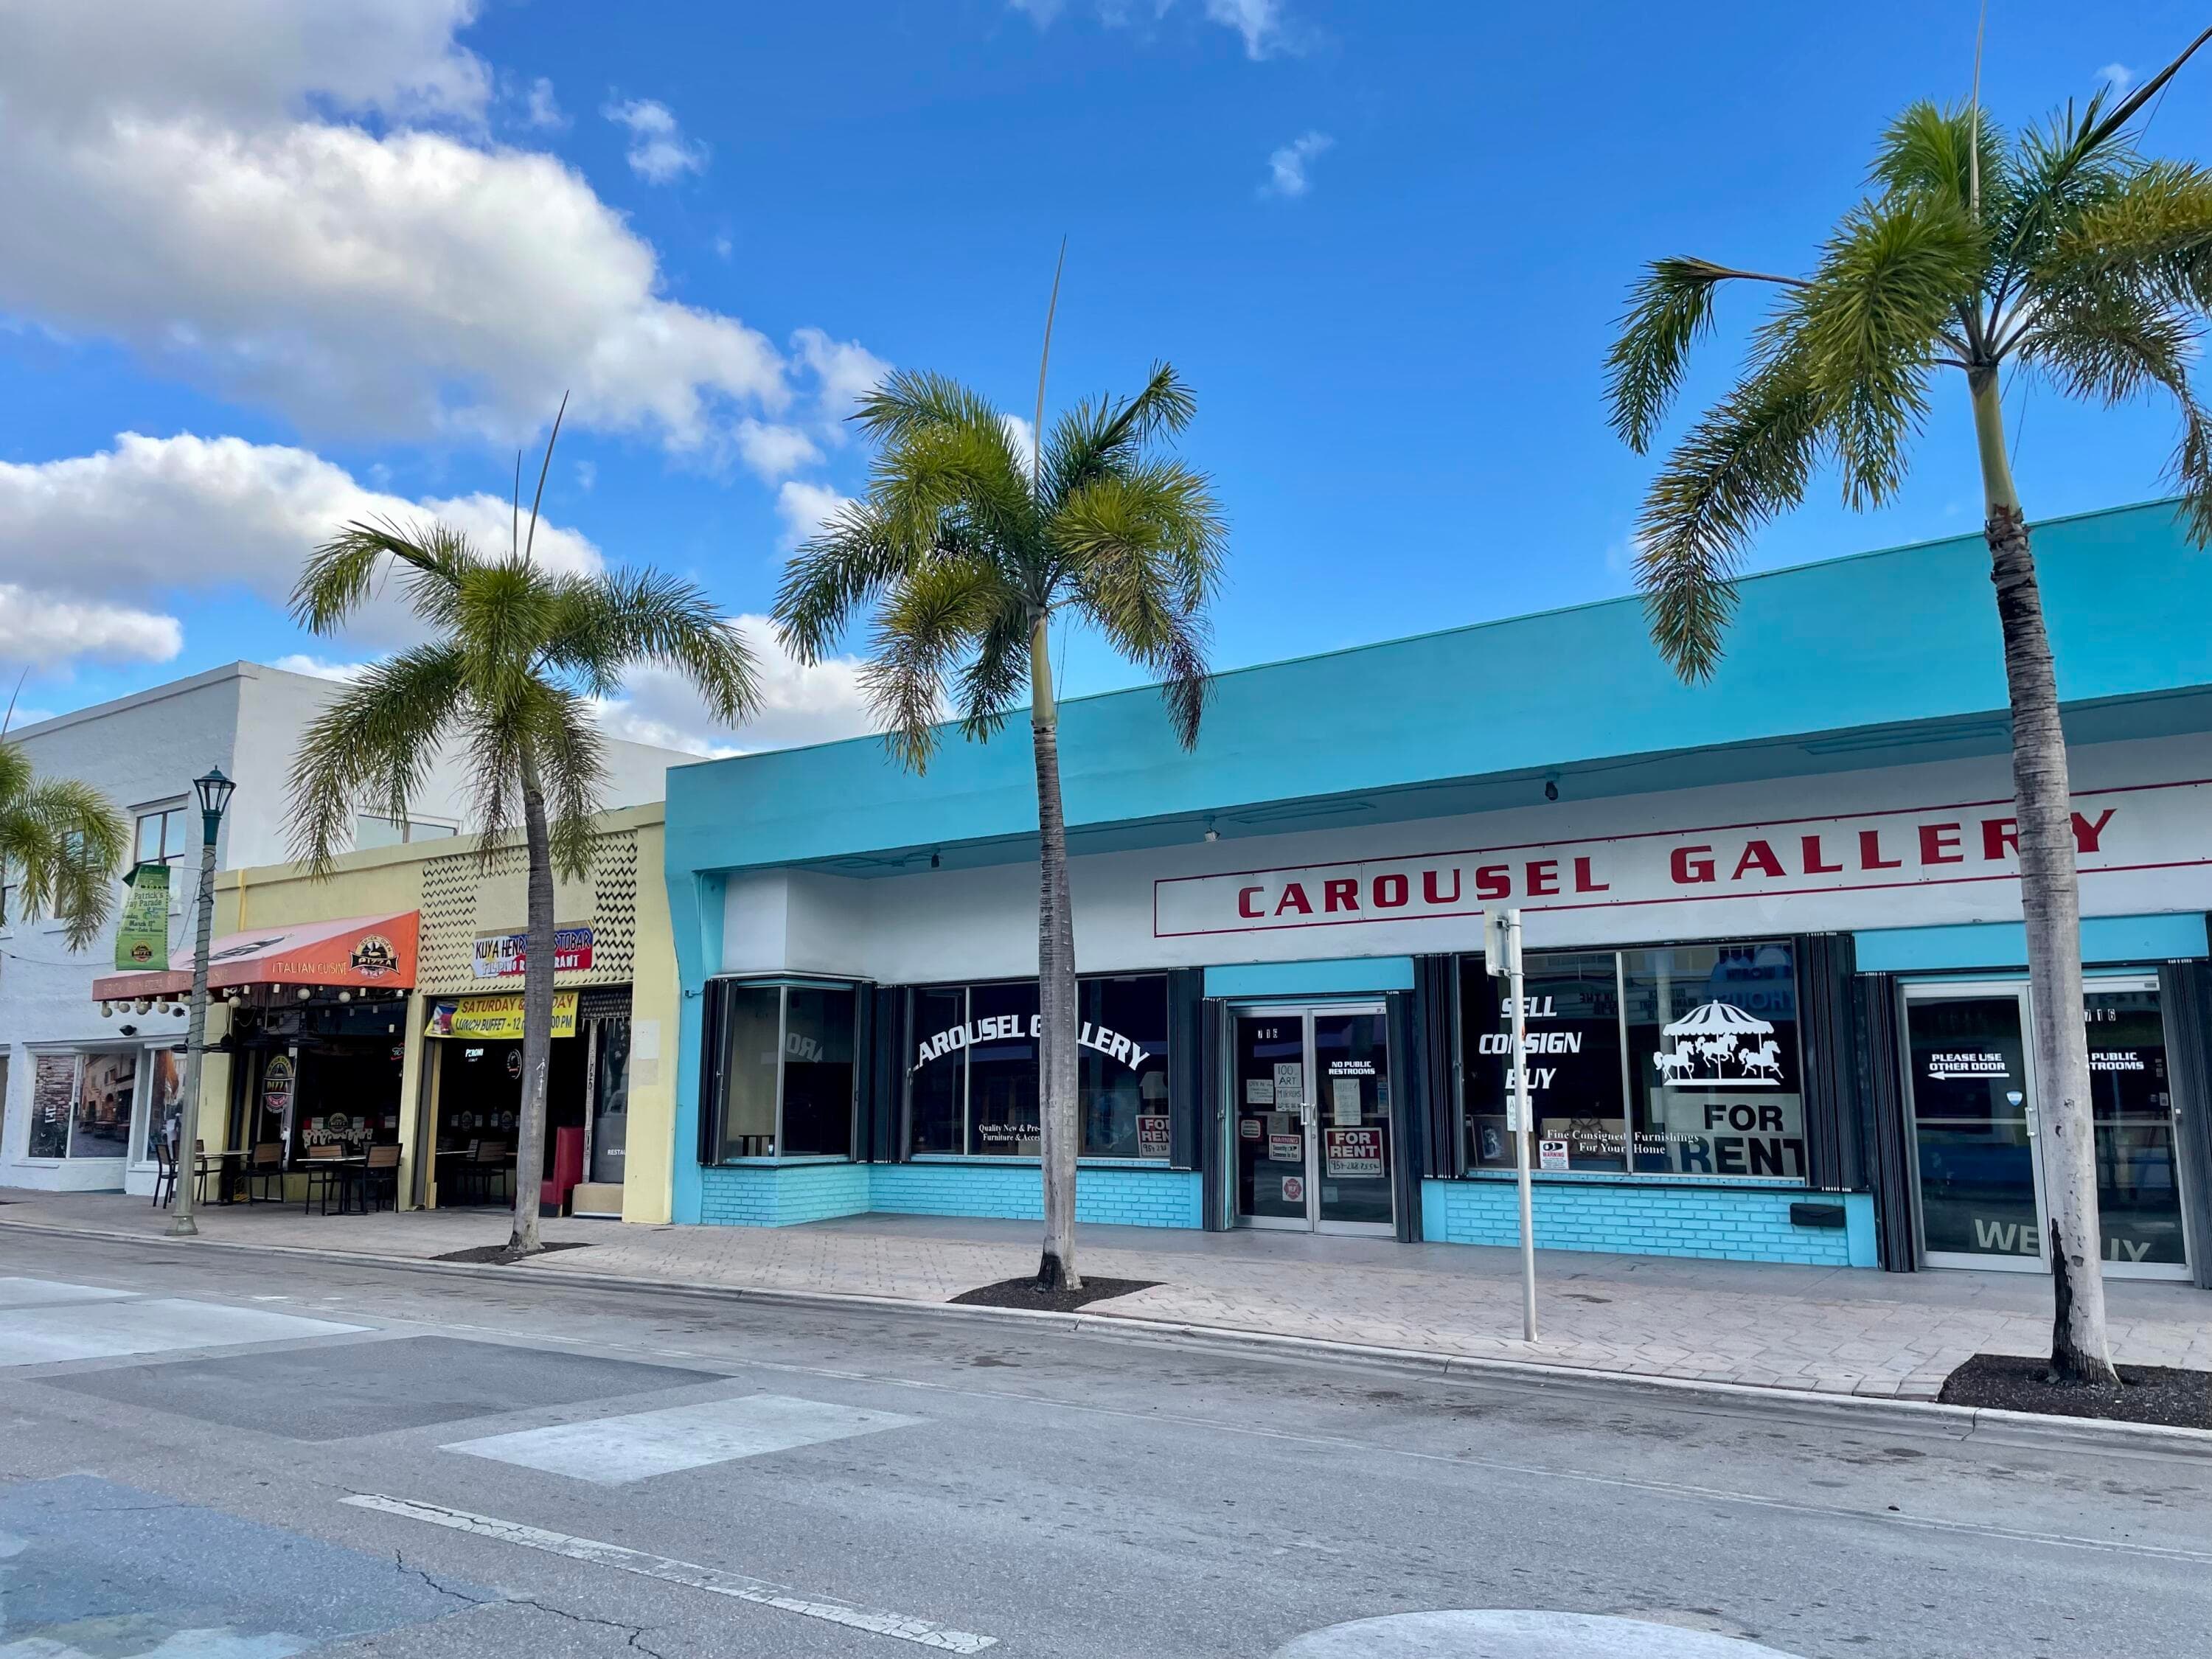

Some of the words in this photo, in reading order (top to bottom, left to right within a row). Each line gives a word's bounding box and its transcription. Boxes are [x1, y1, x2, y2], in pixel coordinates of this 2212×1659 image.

[1238, 857, 1610, 919] CAROUSEL
[1669, 808, 2118, 884] GALLERY
[139, 899, 162, 907] Parade
[476, 939, 499, 960] KUYA
[554, 931, 591, 952] STOBAR
[358, 957, 392, 967] PIZZA
[483, 960, 517, 975] FILIPINO
[272, 961, 314, 974] ITALIAN
[317, 962, 347, 975] CUISINE
[462, 997, 517, 1014] SATURDAY
[518, 998, 525, 1011] &
[552, 995, 574, 1009] DAY
[2084, 1008, 2116, 1022] 716
[456, 1018, 480, 1032] LUNCH
[480, 1018, 507, 1032] BUFFET
[513, 1018, 521, 1030] 12
[560, 1015, 573, 1029] PM
[1931, 1054, 1977, 1062] PLEASE
[1978, 1053, 2002, 1061] USE
[2091, 1052, 2138, 1061] PUBLIC
[1278, 1065, 1293, 1076] 100
[1929, 1062, 1969, 1071] OTHER
[1971, 1062, 2006, 1071] DOOR
[2090, 1062, 2144, 1070] TROOMS
[1279, 1077, 1297, 1085] ART
[1703, 1104, 1784, 1132] FOR
[978, 1124, 1002, 1133] Quality
[1004, 1124, 1018, 1132] New
[983, 1133, 1013, 1141] Furniture
[1141, 1130, 1169, 1141] REN
[1335, 1133, 1371, 1144] FOR
[1548, 1129, 1569, 1139] Fine
[1572, 1130, 1627, 1142] Consigned
[1634, 1131, 1700, 1144] Furnishings
[1330, 1145, 1377, 1158] RENT
[1579, 1144, 1598, 1152] For
[1601, 1144, 1627, 1153] Your
[1633, 1144, 1666, 1155] Home
[1679, 1136, 1806, 1178] RENT
[1975, 1219, 2040, 1253] WE
